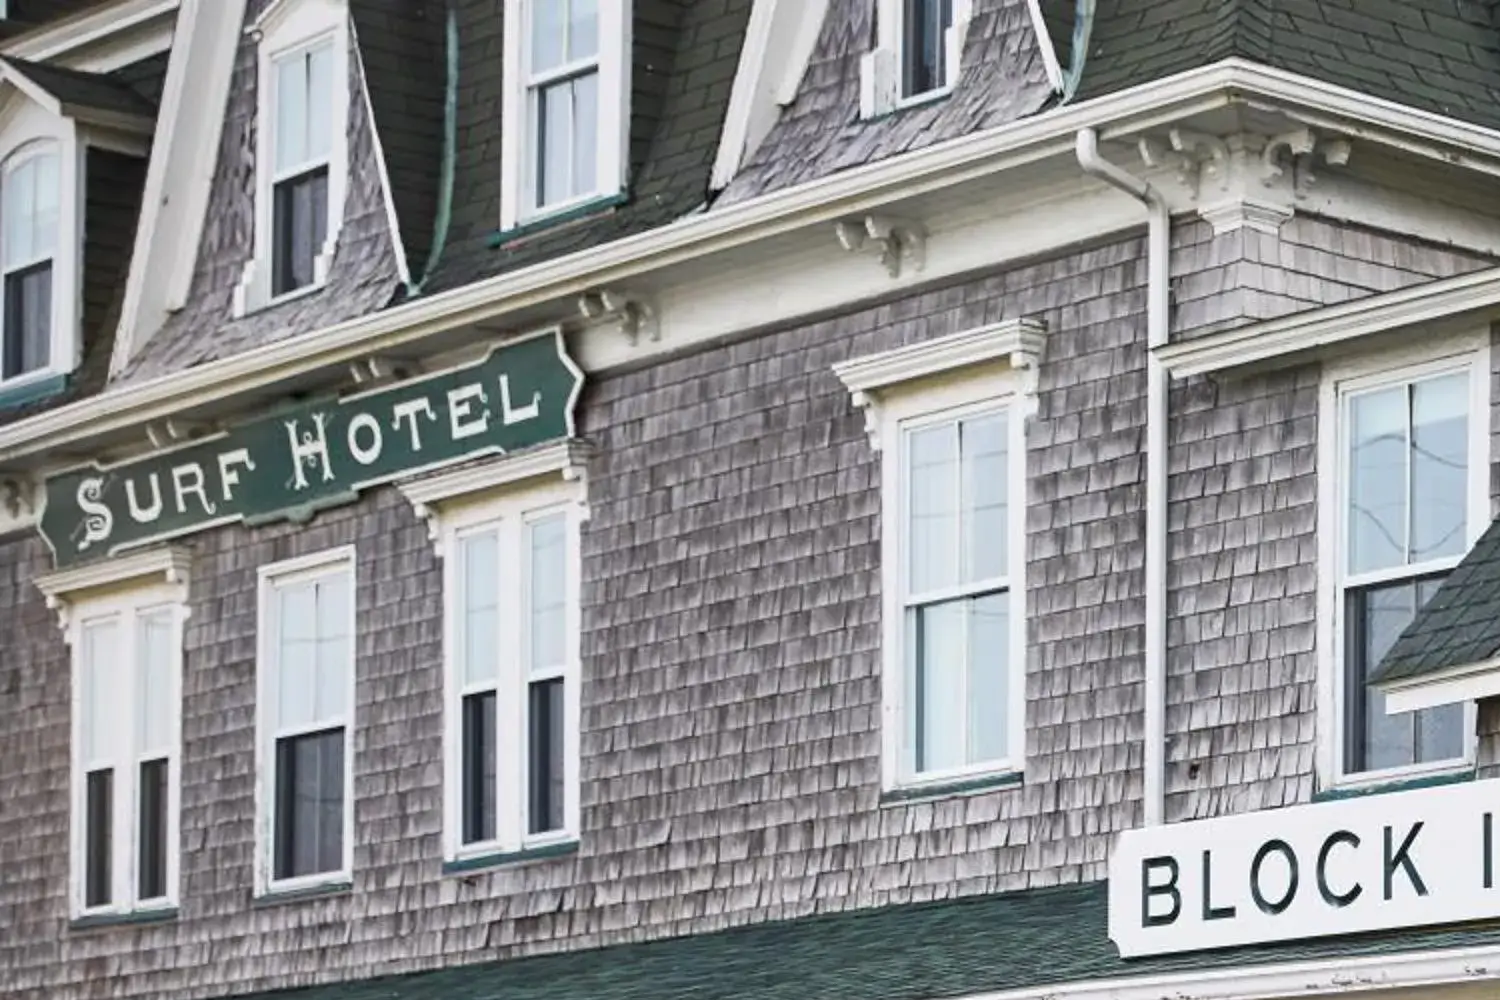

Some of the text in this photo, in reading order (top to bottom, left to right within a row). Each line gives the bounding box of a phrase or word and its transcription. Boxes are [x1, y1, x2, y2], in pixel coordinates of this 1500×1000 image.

[73, 375, 542, 551] SURF HOTEL
[1140, 821, 1430, 929] BLOCK
